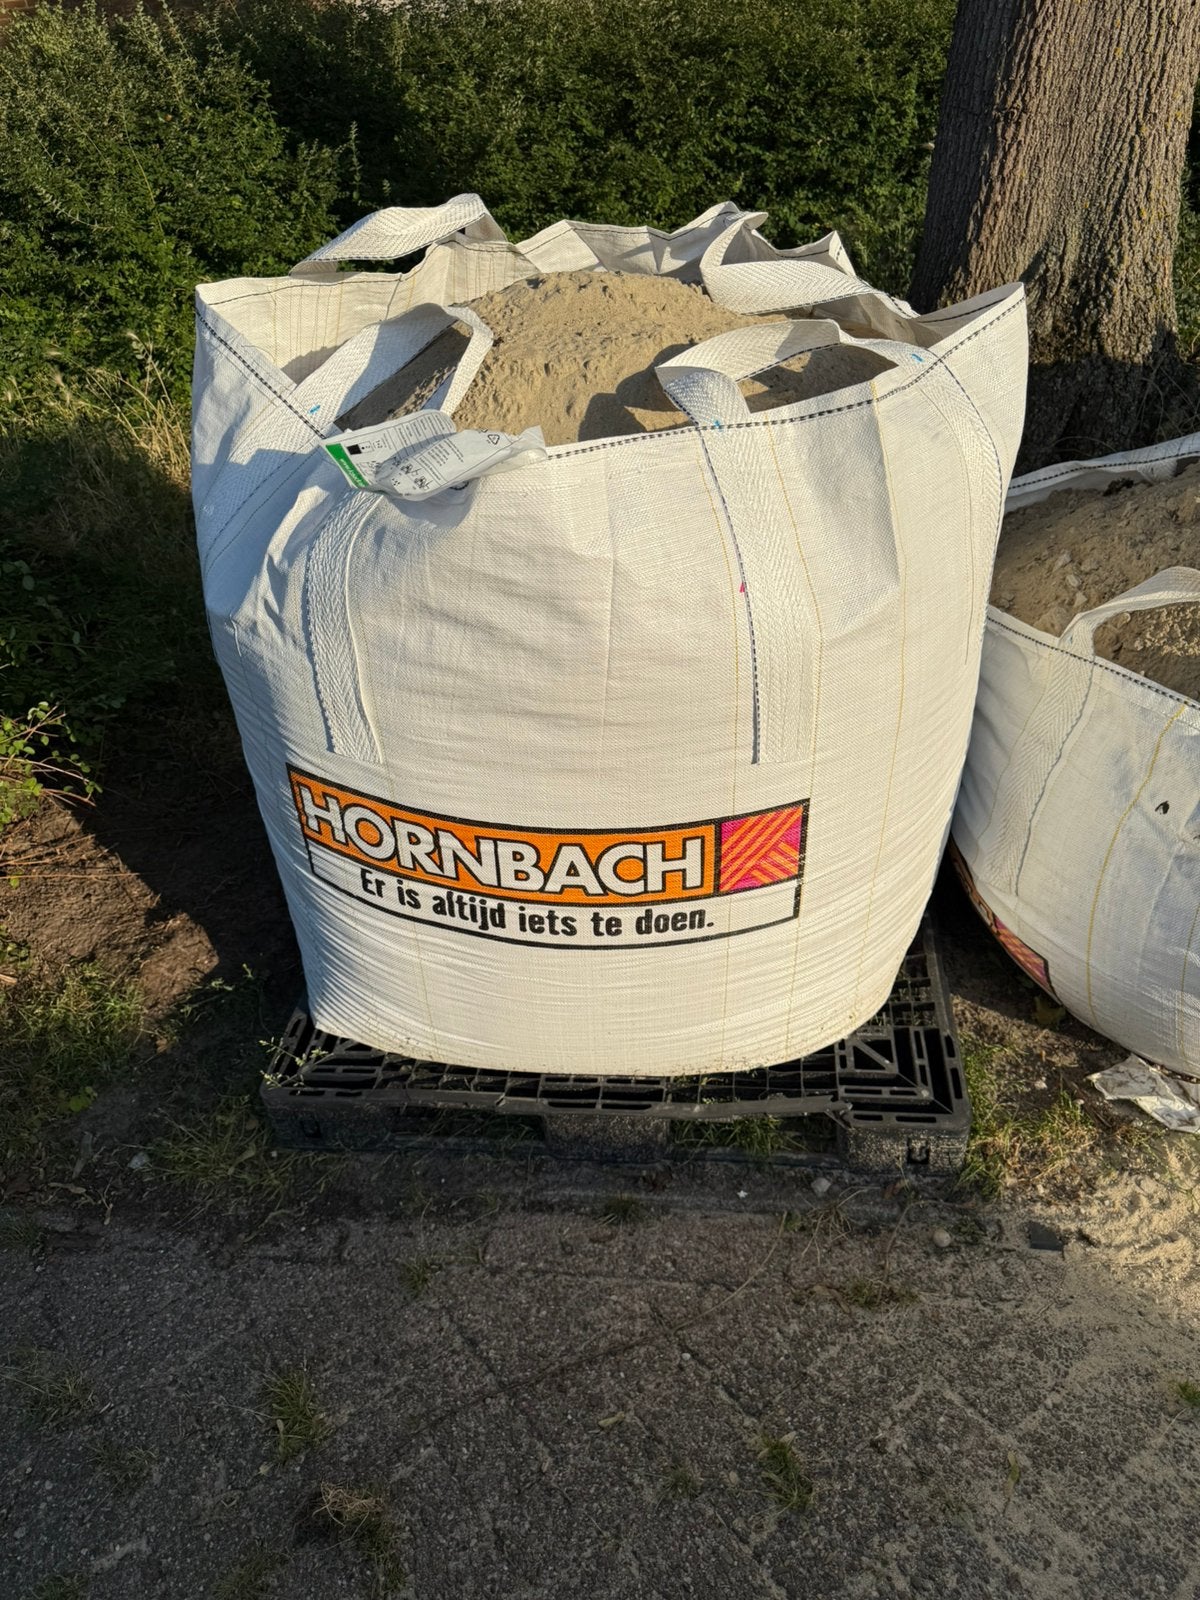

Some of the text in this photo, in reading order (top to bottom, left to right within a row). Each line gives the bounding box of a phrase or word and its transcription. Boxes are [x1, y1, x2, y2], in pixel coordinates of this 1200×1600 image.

[298, 781, 707, 896] HORNBACH
[360, 867, 715, 936] Er is altijd iets te doen.
